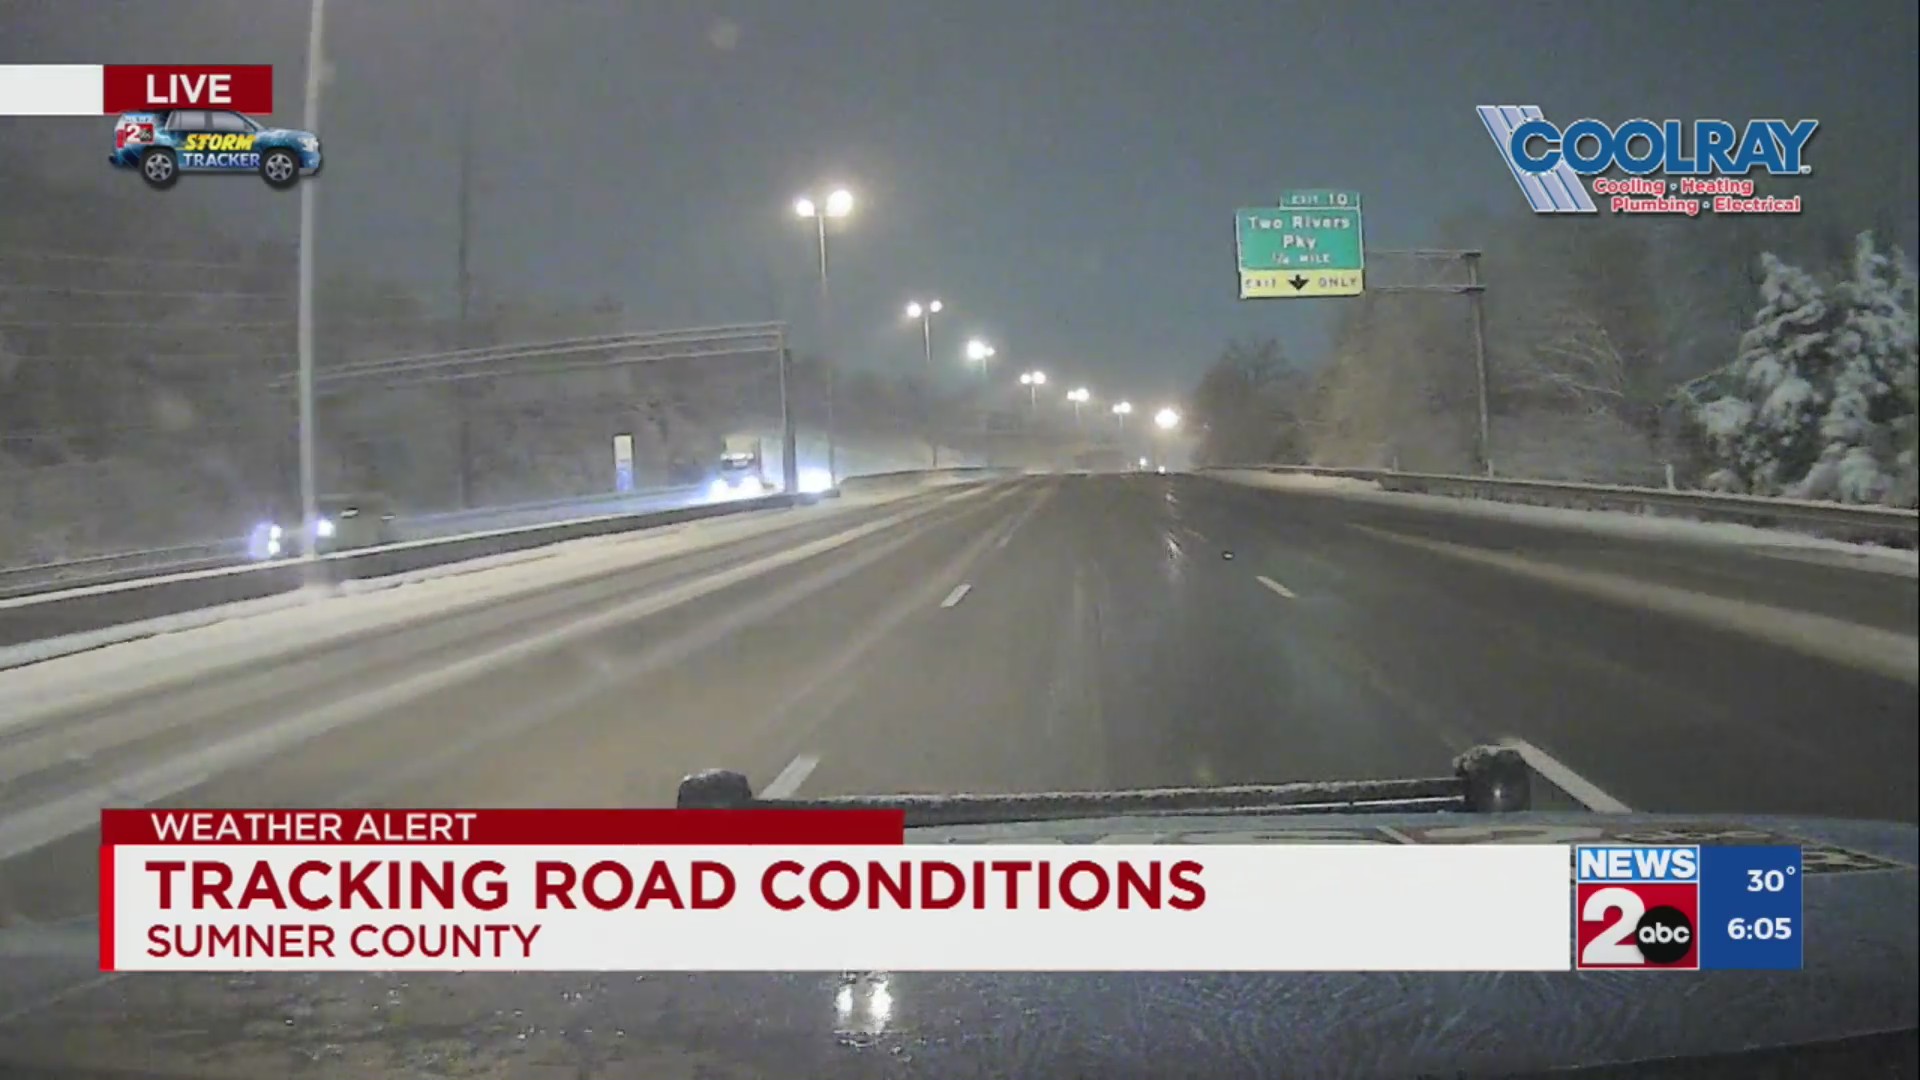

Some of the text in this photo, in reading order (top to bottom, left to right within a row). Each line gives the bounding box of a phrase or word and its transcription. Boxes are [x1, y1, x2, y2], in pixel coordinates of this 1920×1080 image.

[1328, 193, 1349, 205] 10
[1248, 215, 1351, 229] Two Rivers
[1283, 234, 1316, 249] Pky
[1299, 253, 1330, 263] MILE
[1245, 276, 1357, 288] EXIT ONLY
